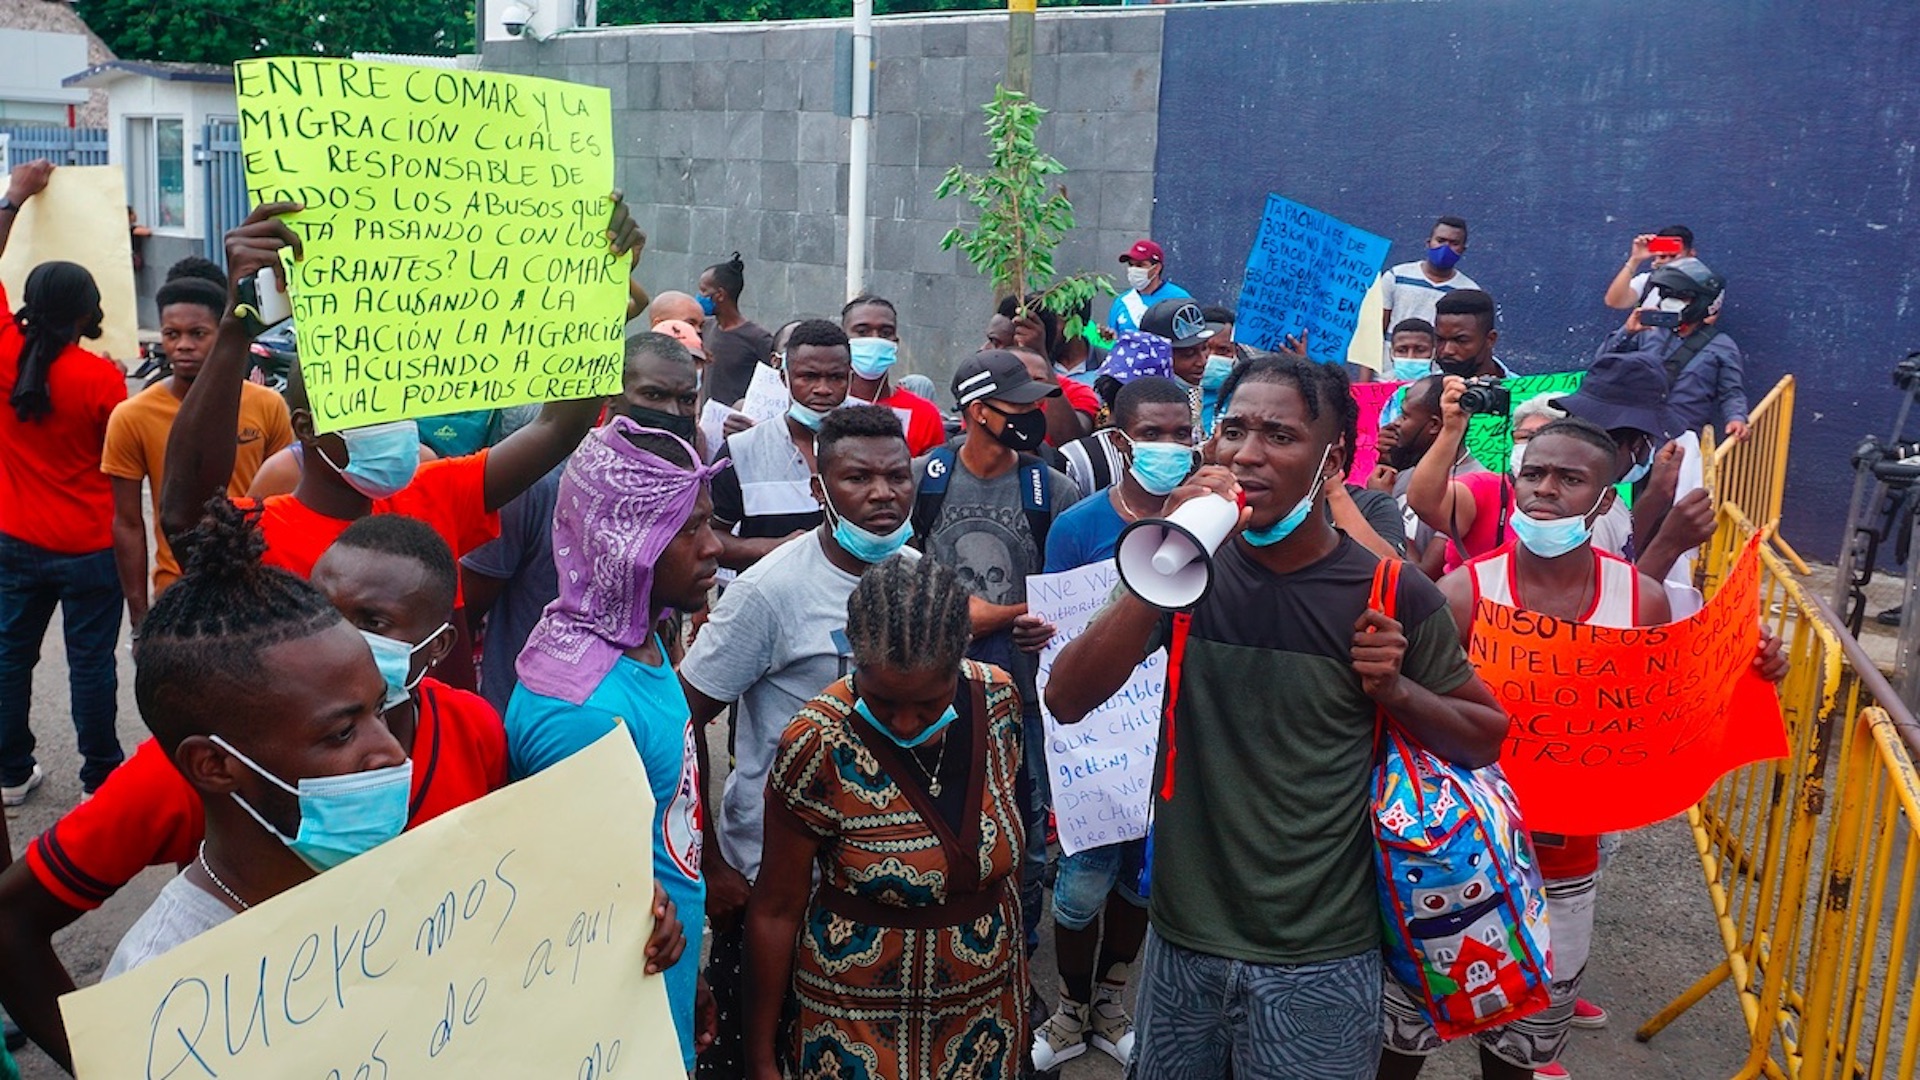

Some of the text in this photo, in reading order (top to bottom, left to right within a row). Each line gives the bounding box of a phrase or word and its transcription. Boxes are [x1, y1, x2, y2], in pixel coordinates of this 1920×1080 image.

[236, 60, 392, 99] ENTRE
[405, 69, 526, 117] COMAR
[561, 91, 590, 117] LA
[244, 144, 585, 189] EL RESPONSABLE DE
[395, 186, 463, 215] LOS
[463, 192, 565, 219] ABUSOS
[354, 217, 484, 245] PASANDO
[496, 224, 557, 249] CON
[565, 221, 609, 249] LOS
[1347, 238, 1368, 254] DE
[469, 250, 508, 280] LA
[522, 252, 624, 285] COMAR
[353, 287, 500, 316] ACUSANDO
[513, 289, 527, 311] A
[541, 286, 575, 313] LA
[1338, 297, 1357, 315] EN
[455, 319, 488, 346] LA
[344, 354, 500, 384] ACUSANDO
[514, 352, 531, 373] A
[542, 351, 622, 378] COMAR
[324, 386, 388, 419] CUAL
[401, 380, 517, 414] PODEMOS
[1084, 567, 1118, 589] WA
[1474, 600, 1669, 646] NOSOTROS
[1472, 633, 1498, 663] NI
[1510, 645, 1618, 677] PELEA
[1646, 650, 1678, 675] NI
[1508, 712, 1646, 738] ACUAR
[1503, 736, 1648, 767] TROS
